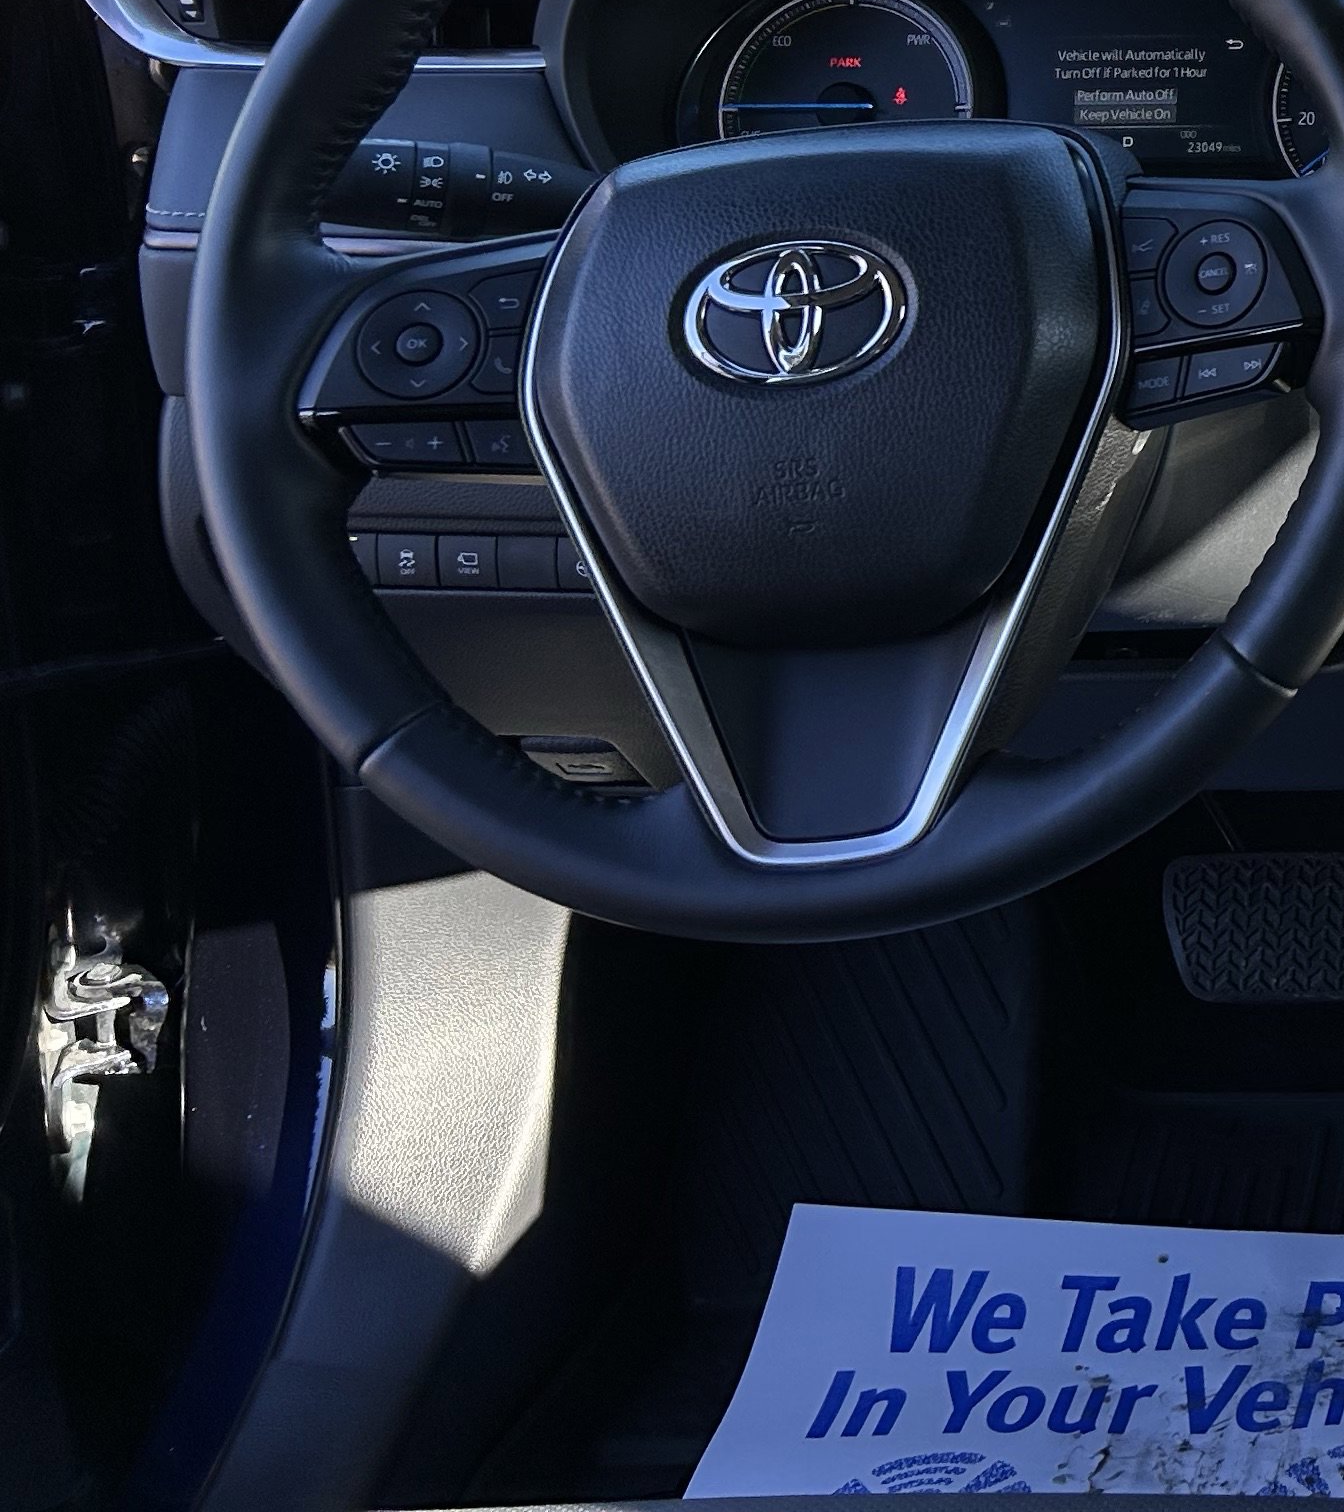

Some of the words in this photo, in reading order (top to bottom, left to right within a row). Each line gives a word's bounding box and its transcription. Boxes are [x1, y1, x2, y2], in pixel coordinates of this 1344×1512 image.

[771, 35, 792, 47] ECO
[906, 33, 932, 46] PWR
[1057, 49, 1100, 62] Vehicle
[1101, 48, 1123, 61] will
[1125, 47, 1206, 63] Automatically
[828, 56, 862, 69] PARK
[1055, 67, 1081, 79] Turn
[1082, 66, 1101, 79] Off
[1103, 67, 1112, 79] if
[1113, 66, 1153, 79] Parked
[1154, 66, 1171, 79] for
[1173, 67, 1179, 78] 1
[1181, 67, 1207, 78] Hour
[1077, 89, 1124, 102] Perform
[1125, 89, 1154, 101] Auto
[1155, 88, 1175, 101] Off
[1079, 108, 1109, 123] Keep
[1111, 107, 1153, 121] Vehicle
[1154, 108, 1171, 120] On
[1297, 111, 1316, 127] 20
[1186, 141, 1223, 153] 23049
[491, 192, 514, 203] OFF
[413, 199, 444, 210] AUTO
[1210, 233, 1231, 245] RES
[1199, 267, 1231, 279] CANCEL
[1211, 303, 1231, 315] SET
[406, 338, 428, 350] OK
[1137, 376, 1170, 389] MODE
[457, 567, 480, 576] VIEW
[888, 1265, 1027, 1355] We
[1060, 1271, 1268, 1355] Take
[804, 1369, 907, 1440] In
[941, 1367, 1173, 1436] Your
